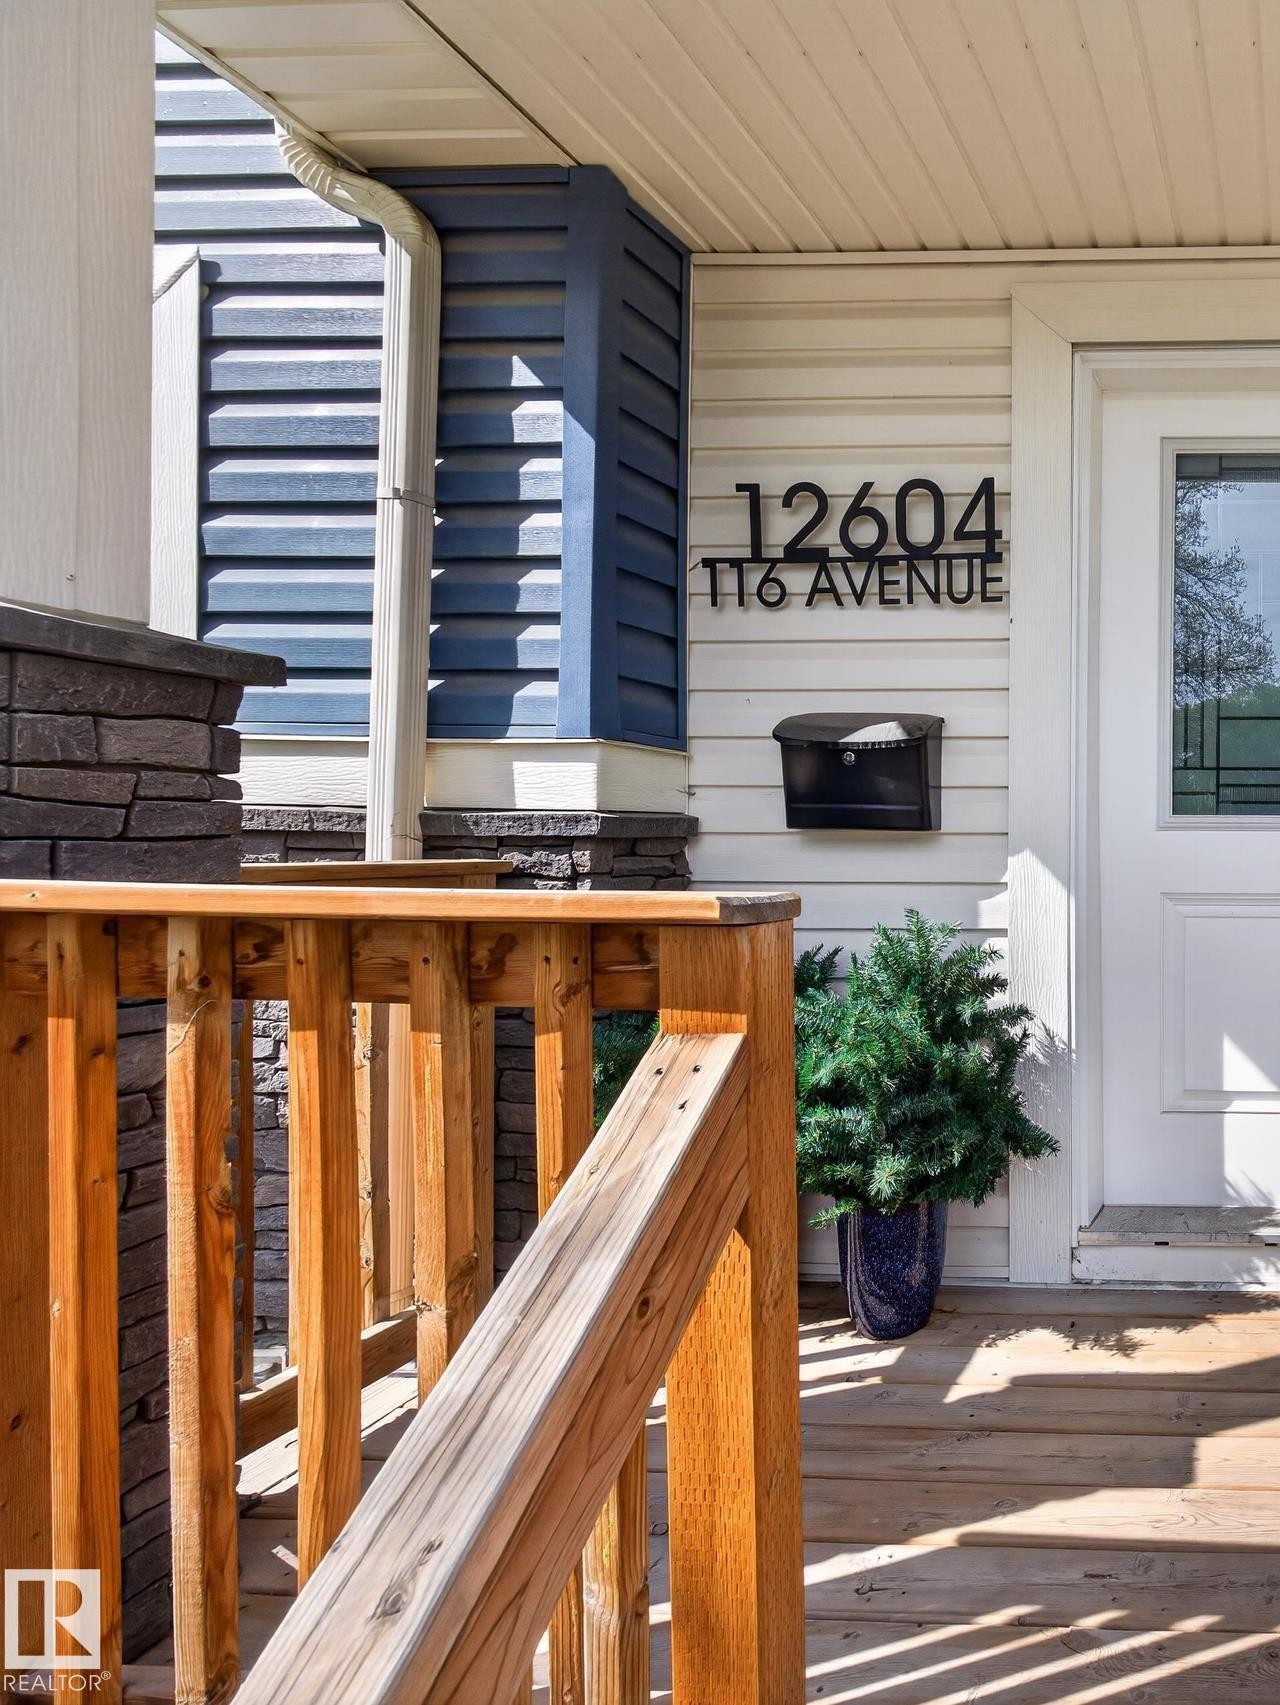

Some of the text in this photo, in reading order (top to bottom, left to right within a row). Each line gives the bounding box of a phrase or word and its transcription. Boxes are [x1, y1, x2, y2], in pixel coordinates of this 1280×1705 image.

[734, 477, 1004, 559] 12604
[702, 557, 1004, 608] 116 AVENUE
